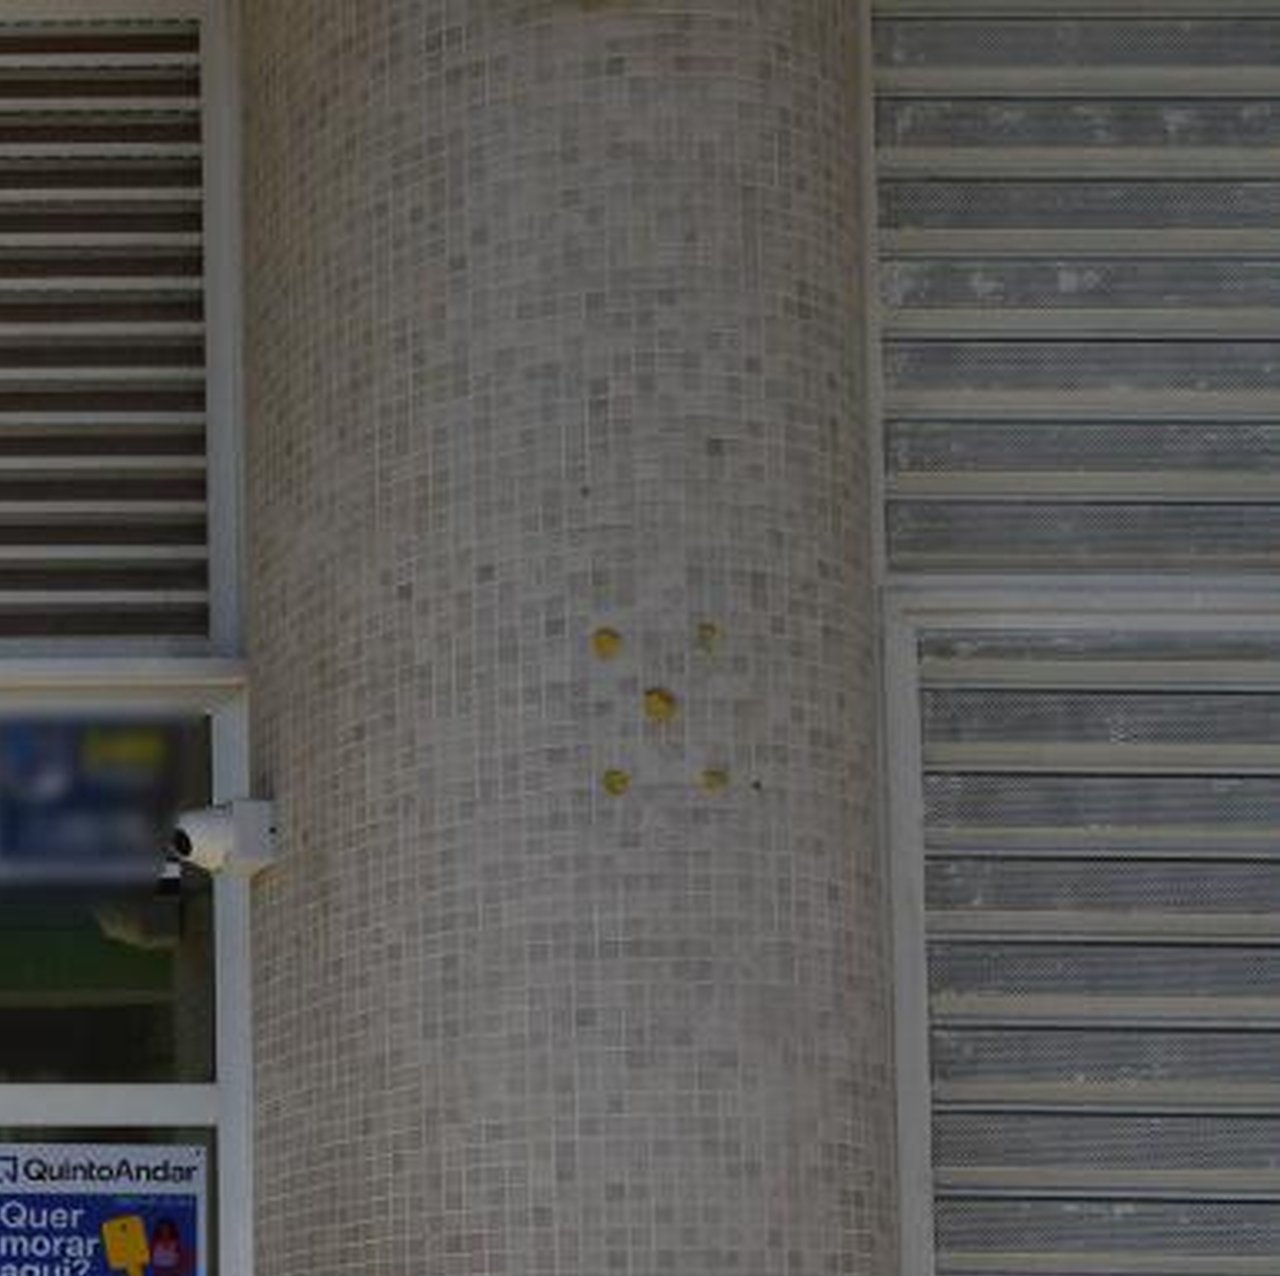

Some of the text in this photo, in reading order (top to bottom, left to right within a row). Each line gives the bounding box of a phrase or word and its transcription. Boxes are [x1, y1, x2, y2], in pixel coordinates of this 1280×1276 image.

[24, 1158, 197, 1182] QuintoAndar
[0, 1201, 85, 1229] Quer
[0, 1235, 100, 1257] morar
